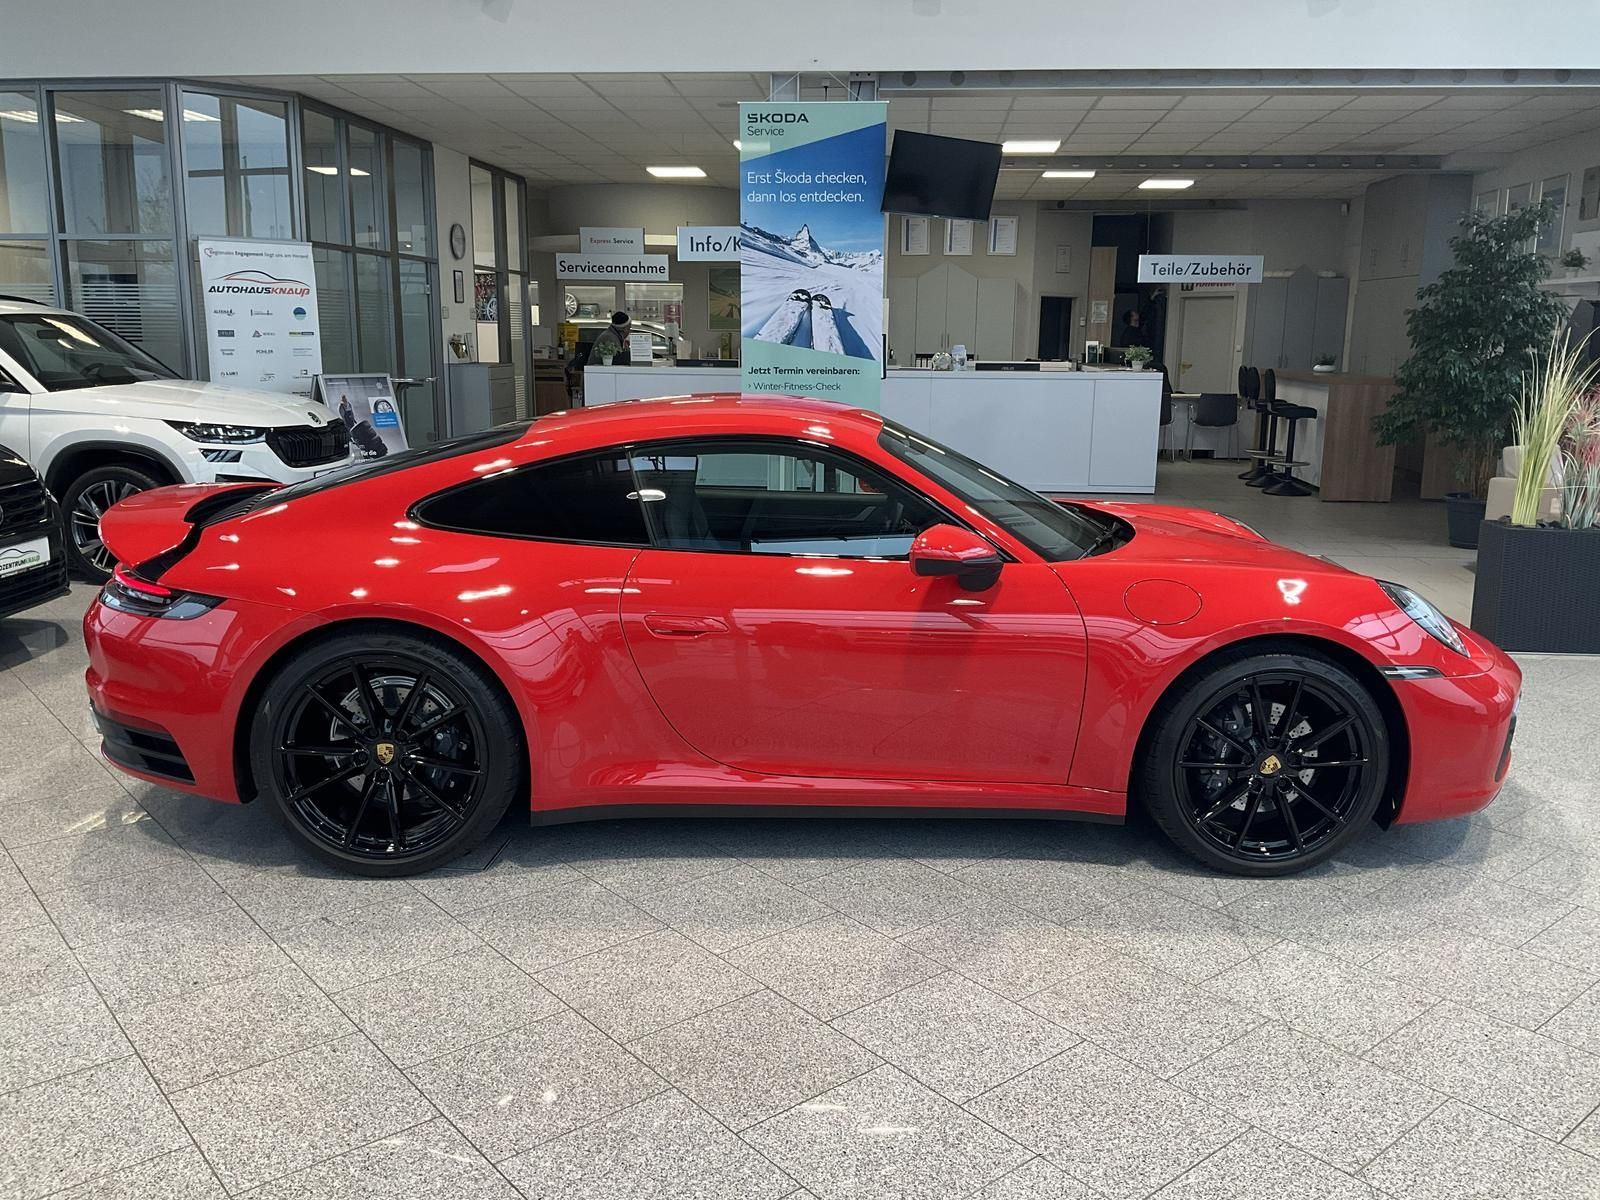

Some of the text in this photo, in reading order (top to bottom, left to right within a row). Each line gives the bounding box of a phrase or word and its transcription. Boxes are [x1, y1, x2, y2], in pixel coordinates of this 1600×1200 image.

[747, 126, 785, 137] Service
[747, 169, 867, 185] Erst Škoda checken,
[747, 191, 865, 203] dann los entdecken.
[559, 260, 666, 274] Serviceannahme
[1151, 262, 1252, 276] Teile/Zubehör
[748, 367, 861, 375] Jetzt Termin vereinbaren:
[753, 382, 842, 391] Winter-Fitness-Check
